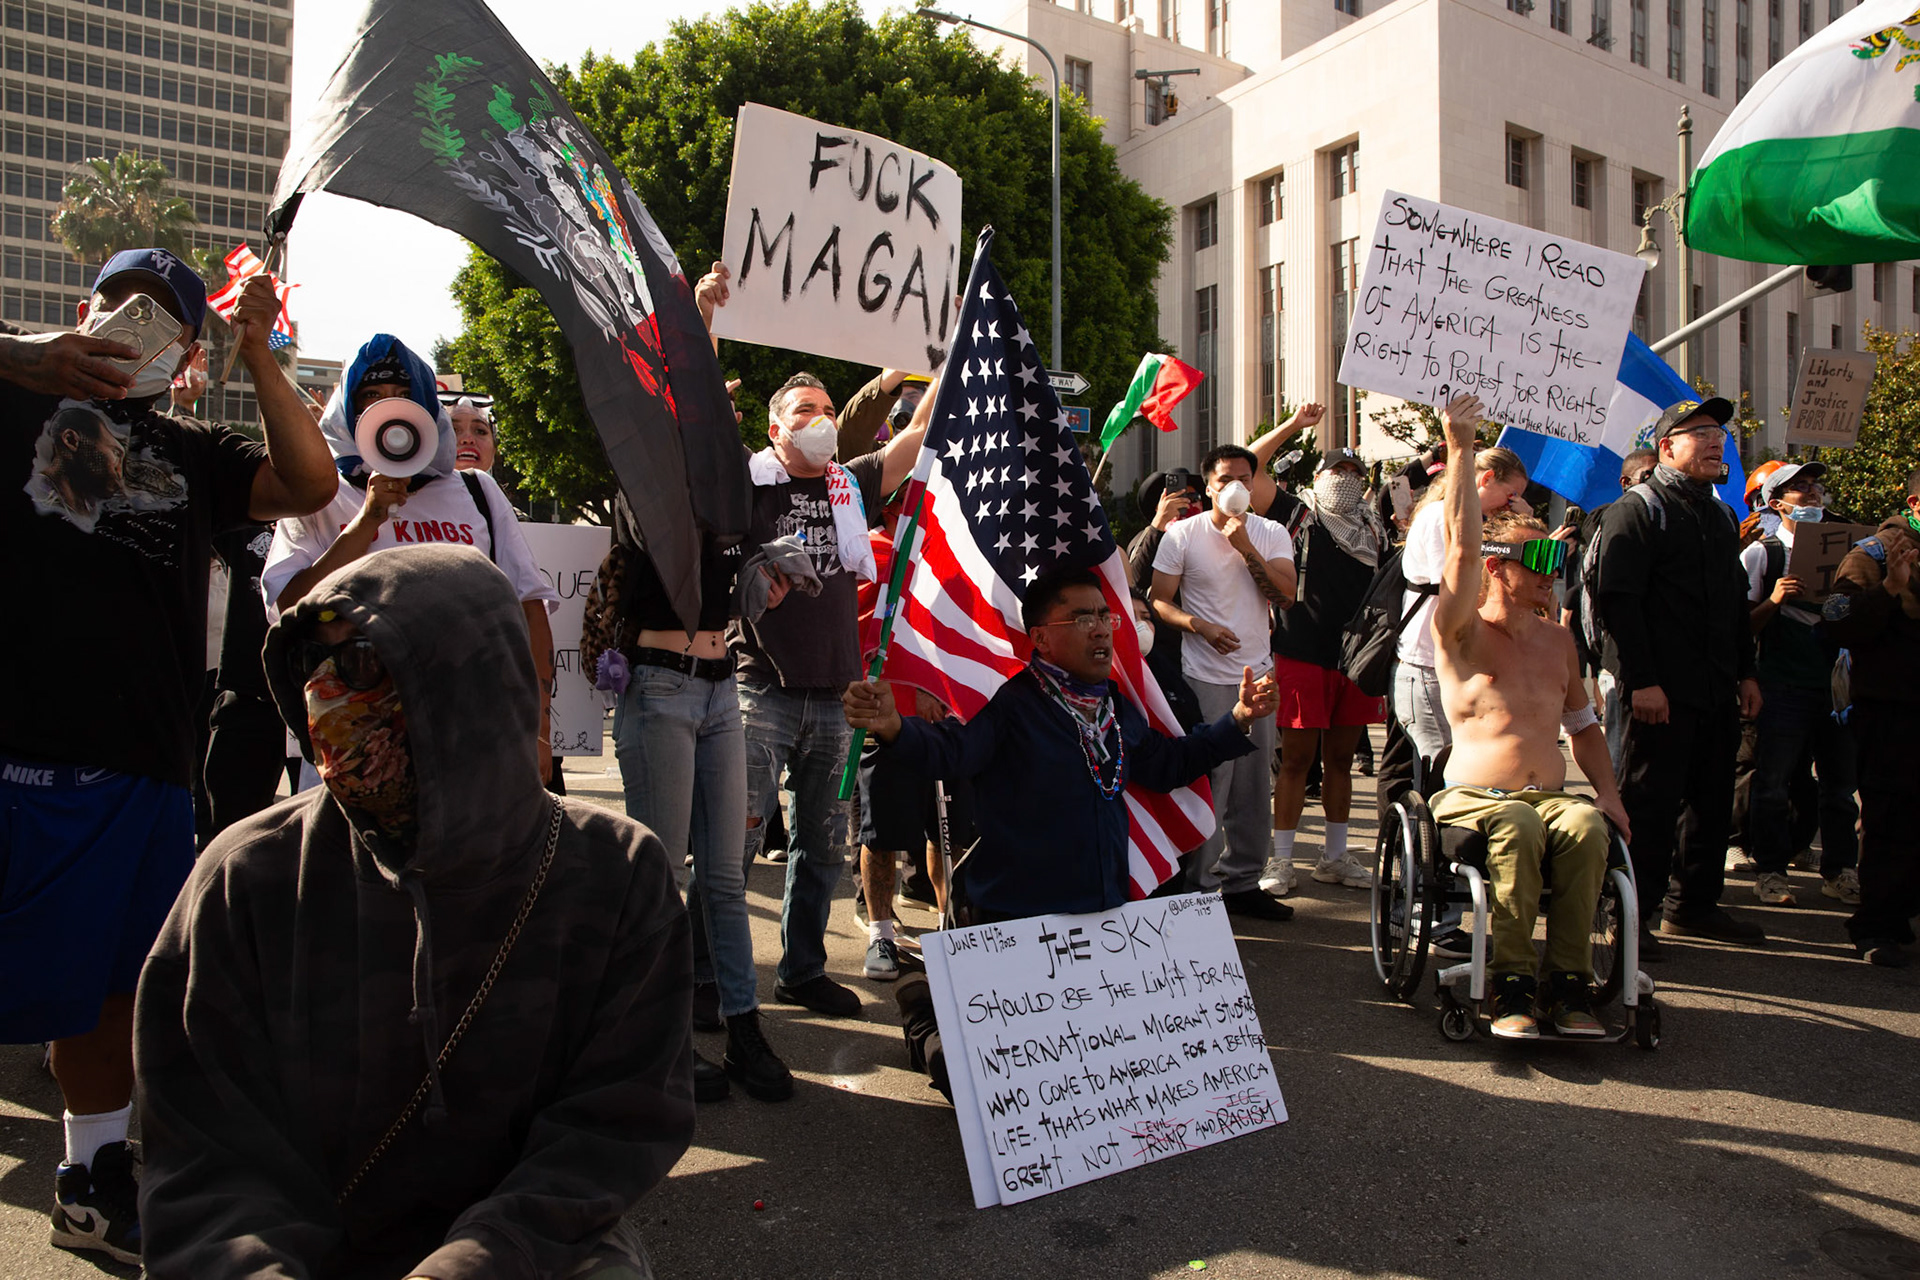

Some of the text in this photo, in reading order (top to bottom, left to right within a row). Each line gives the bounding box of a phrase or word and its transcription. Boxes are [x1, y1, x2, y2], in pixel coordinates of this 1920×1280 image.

[809, 132, 941, 230] FUCK
[1384, 197, 1605, 287] SOMEWHERE I READ
[737, 206, 955, 372] MAGA!
[1374, 235, 1589, 330] THAT THE GREATNESS
[1364, 285, 1602, 377] OF AMERICA IS THE
[1058, 378, 1074, 387] WAY
[1352, 331, 1606, 426] RIGHT TO PROTEST FOR RIGHTS
[1801, 391, 1848, 409] Justice
[1807, 378, 1828, 388] and
[1808, 359, 1854, 382] Liberty
[1544, 415, 1567, 438] KING
[1796, 409, 1854, 433] FOR ALL
[393, 519, 474, 545] KINGS
[2, 763, 55, 787] NIKE
[947, 932, 978, 956] JUNE
[1038, 910, 1169, 979] THE SKY
[966, 959, 1244, 1027] SHOULD BE THE LIMIT FOR ALL
[977, 1020, 1137, 1080] INTERNATIONAL
[1143, 1003, 1212, 1042] MIGRANT
[986, 1024, 1267, 1120] WHO COME TO AMERICA FOR A BETTER
[992, 1062, 1269, 1156] LIFE. THATS WHAT MAKES AMERICA
[1082, 1131, 1122, 1172] NOT
[1194, 1120, 1216, 1140] AND
[1216, 1098, 1278, 1135] RACISM
